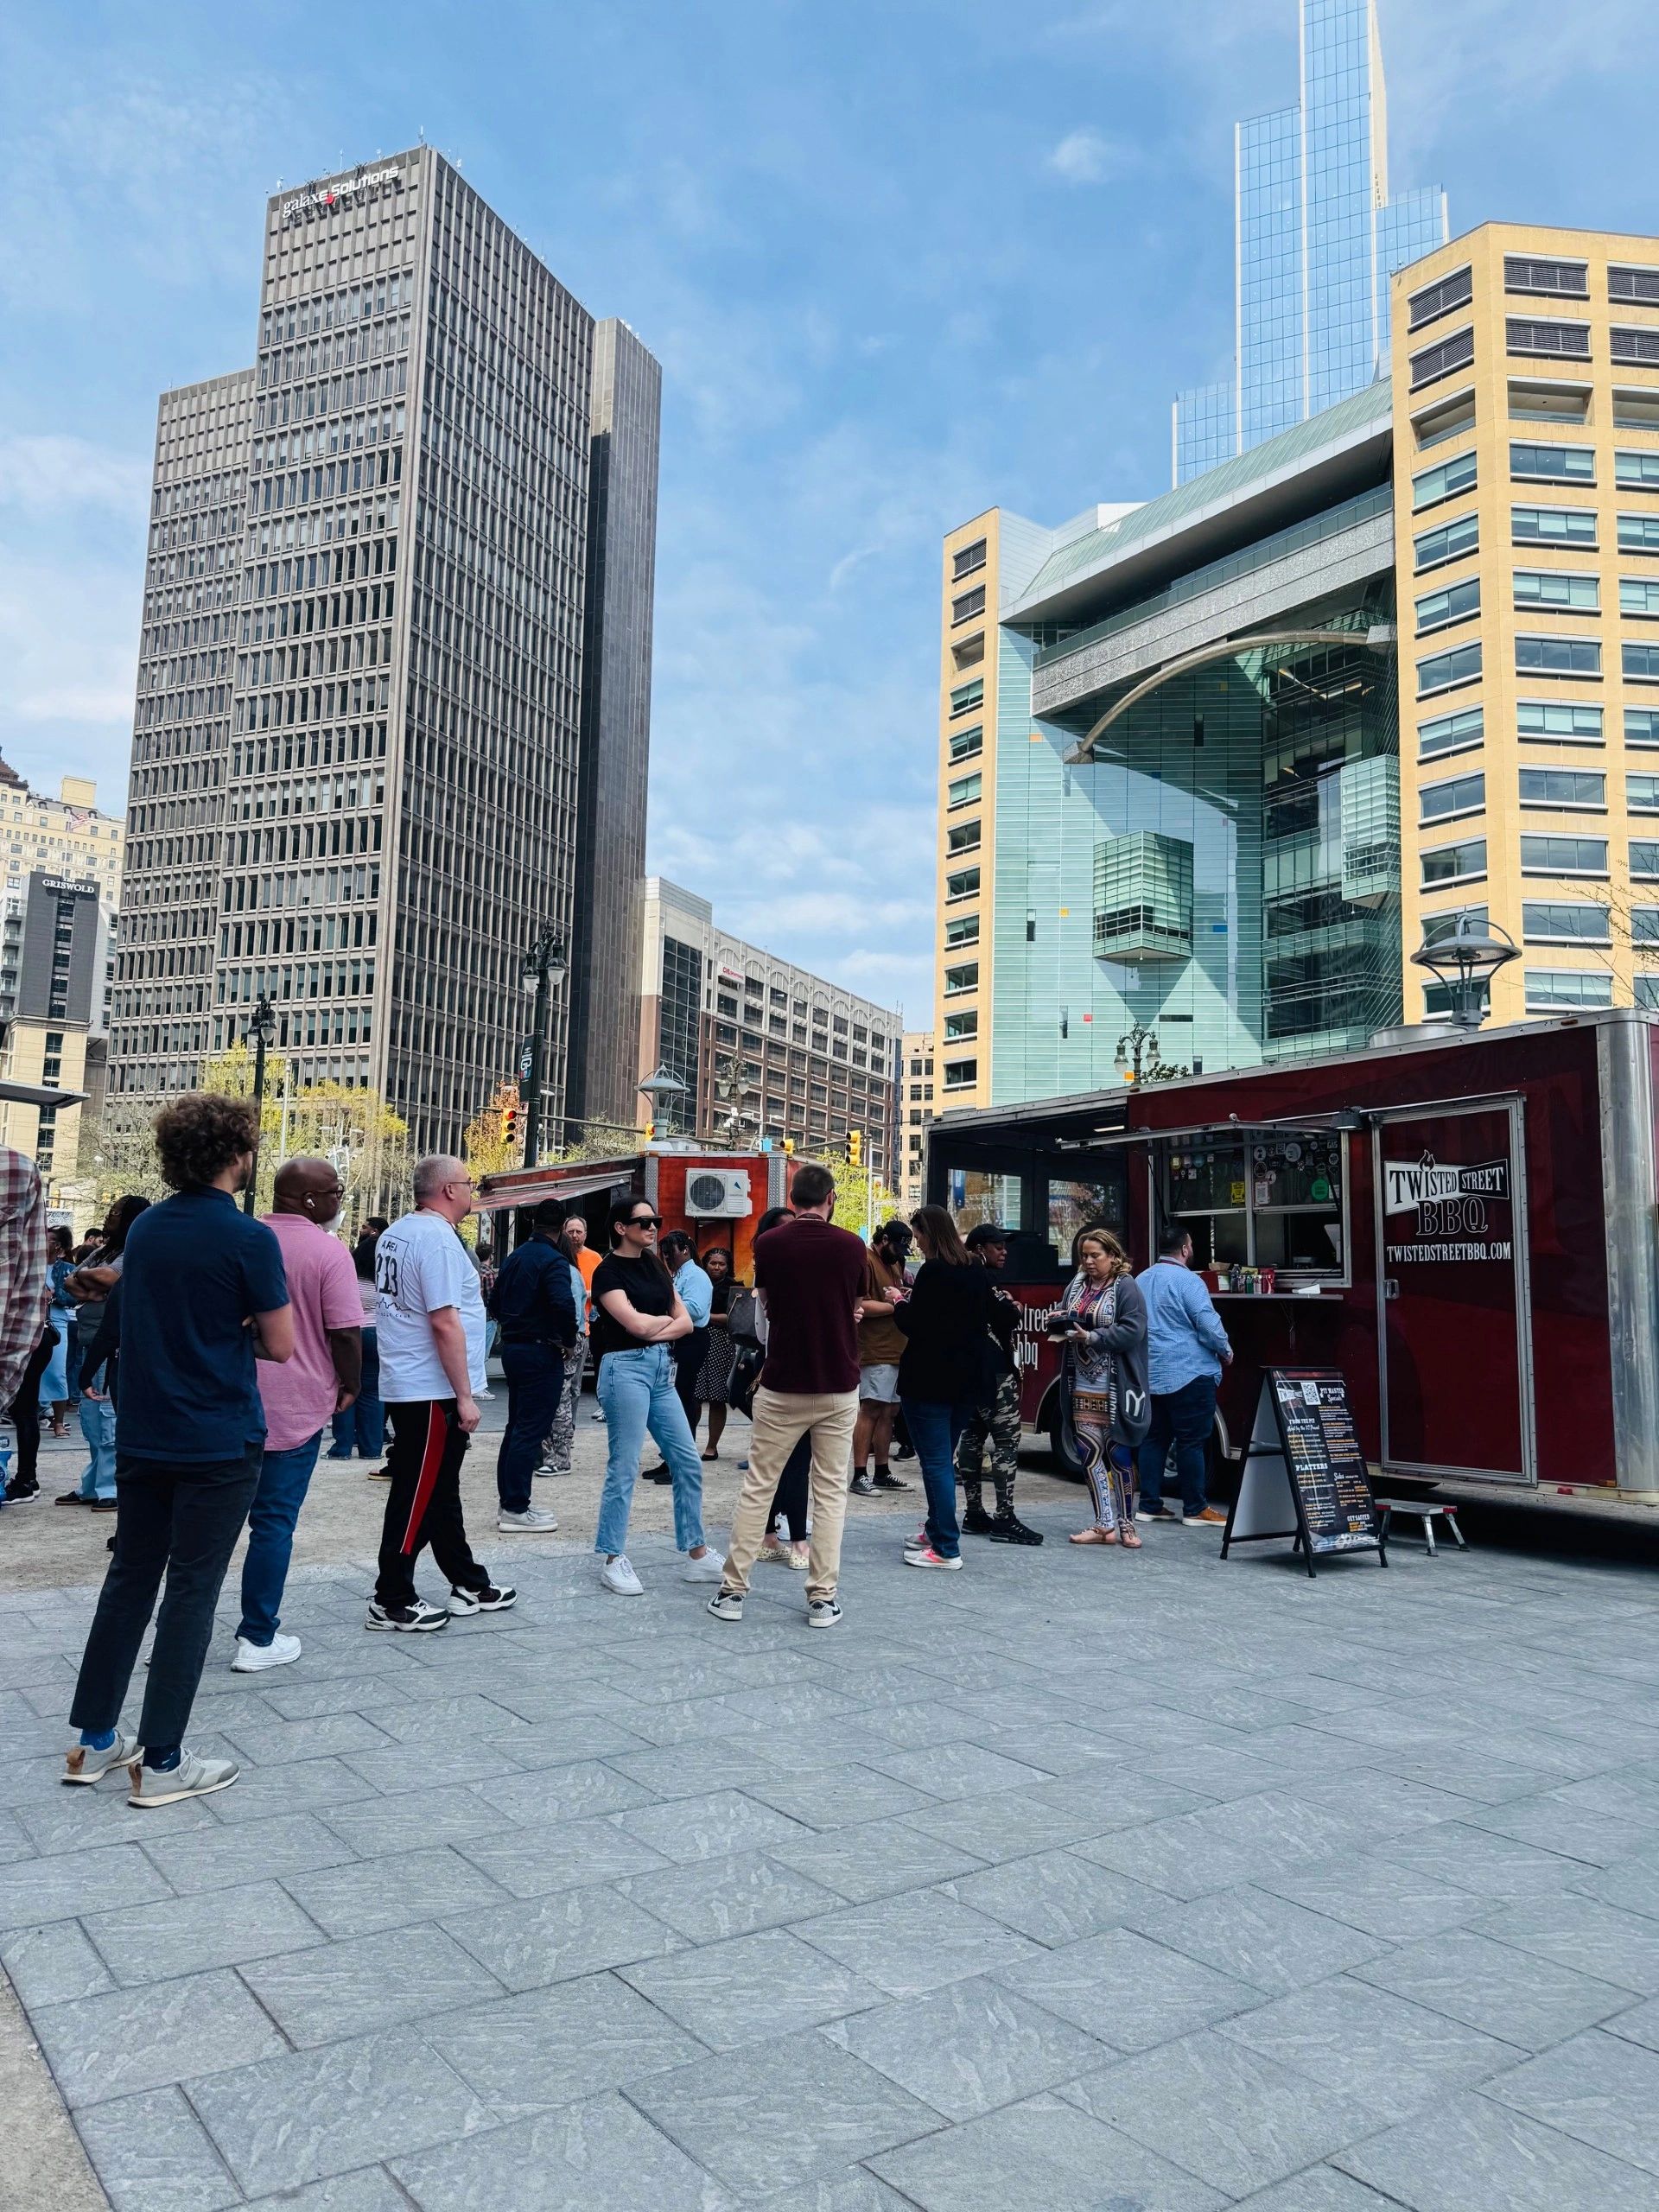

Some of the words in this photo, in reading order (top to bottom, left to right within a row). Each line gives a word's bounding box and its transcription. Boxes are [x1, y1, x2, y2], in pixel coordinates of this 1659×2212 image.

[42, 879, 95, 893] GRISWOLD
[1389, 1169, 1458, 1205] TWISTED
[1461, 1167, 1504, 1192] STREET
[1415, 1196, 1489, 1236] BBQ
[381, 1240, 397, 1253] AREA
[1387, 1242, 1512, 1262] TWISTEDSTREETBBQ.COM
[1295, 1463, 1328, 1471] PLATTERS
